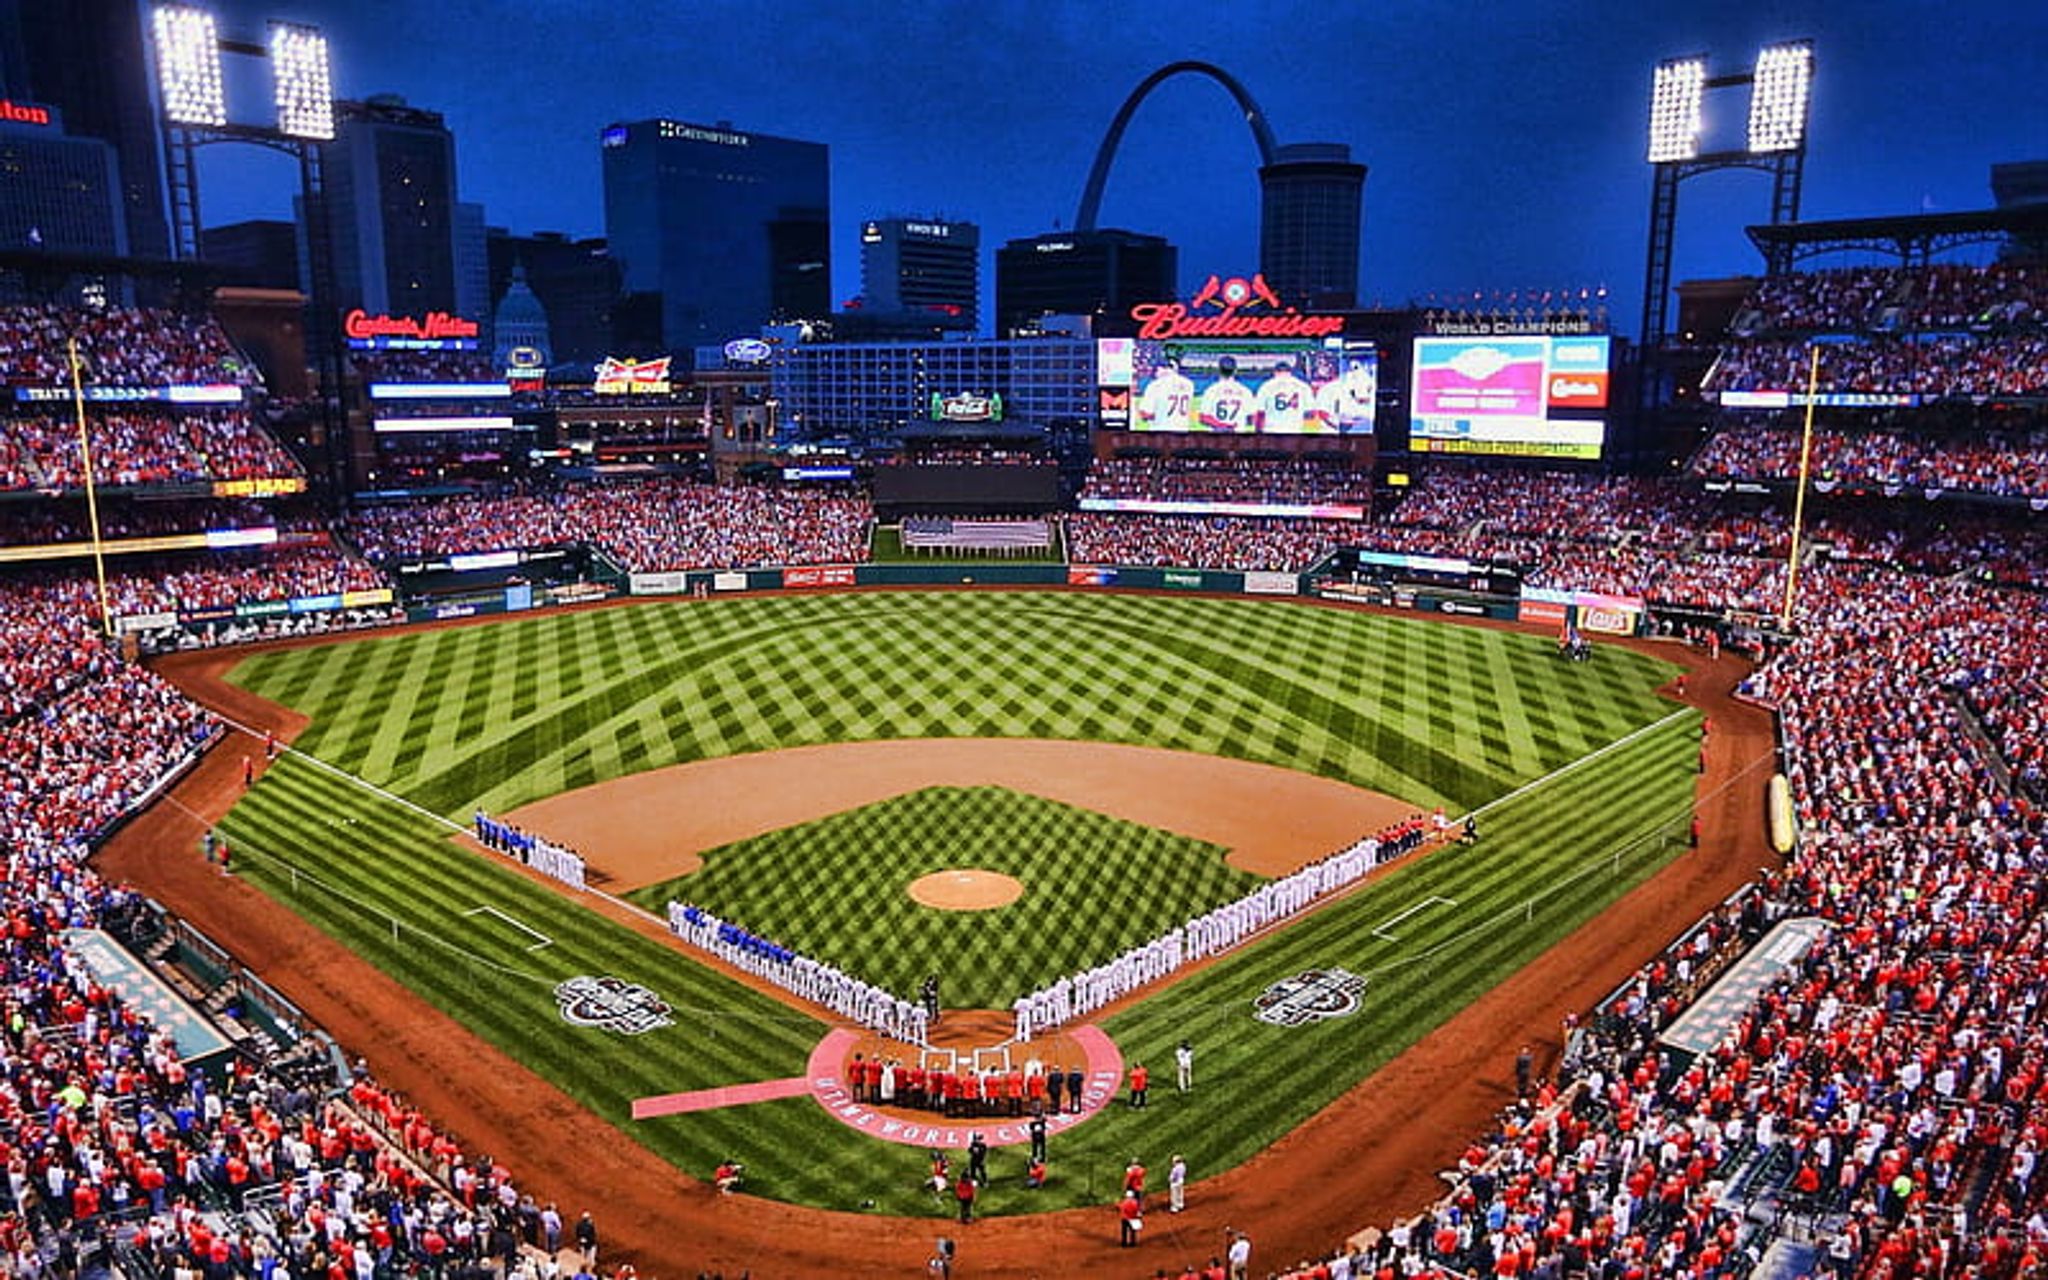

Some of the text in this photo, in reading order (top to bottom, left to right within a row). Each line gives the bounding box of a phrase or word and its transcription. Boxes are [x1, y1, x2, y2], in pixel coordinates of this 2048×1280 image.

[1131, 303, 1344, 338] Budweiser
[1215, 400, 1241, 421] 67
[1274, 393, 1299, 411] 64
